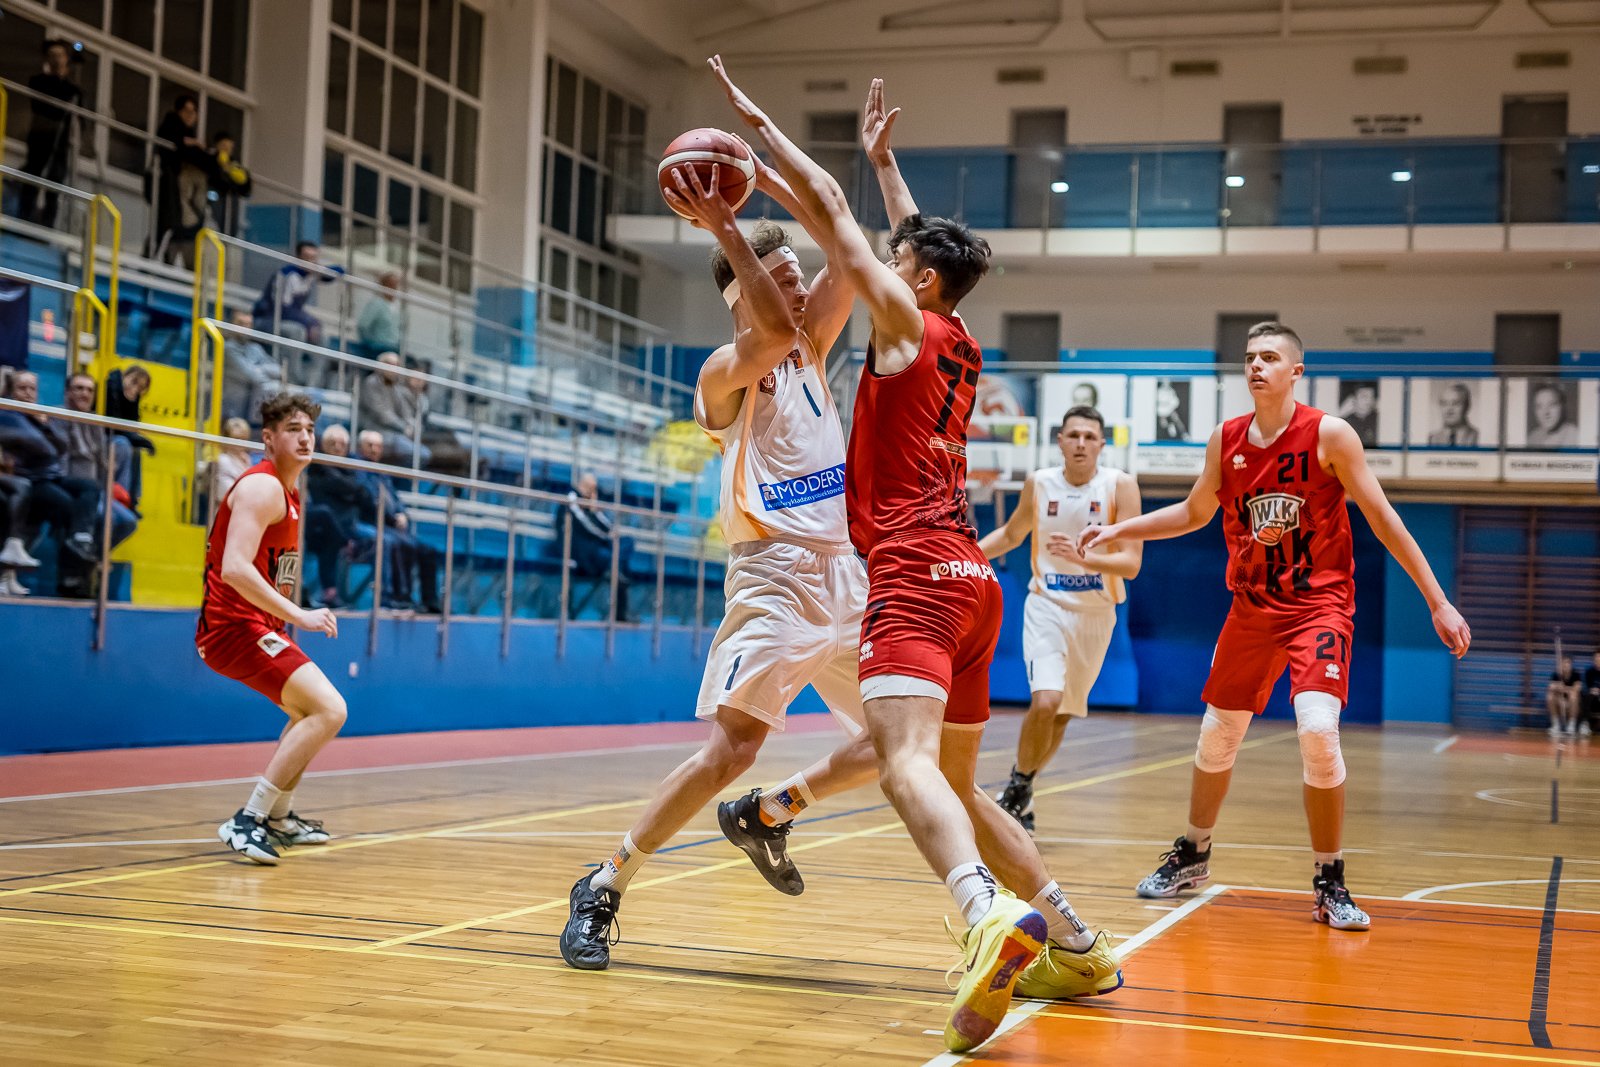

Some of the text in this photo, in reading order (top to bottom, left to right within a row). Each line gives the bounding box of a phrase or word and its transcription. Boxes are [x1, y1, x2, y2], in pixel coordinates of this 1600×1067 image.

[802, 382, 822, 418] 1
[1278, 451, 1309, 485] 21
[1316, 631, 1347, 664] 21
